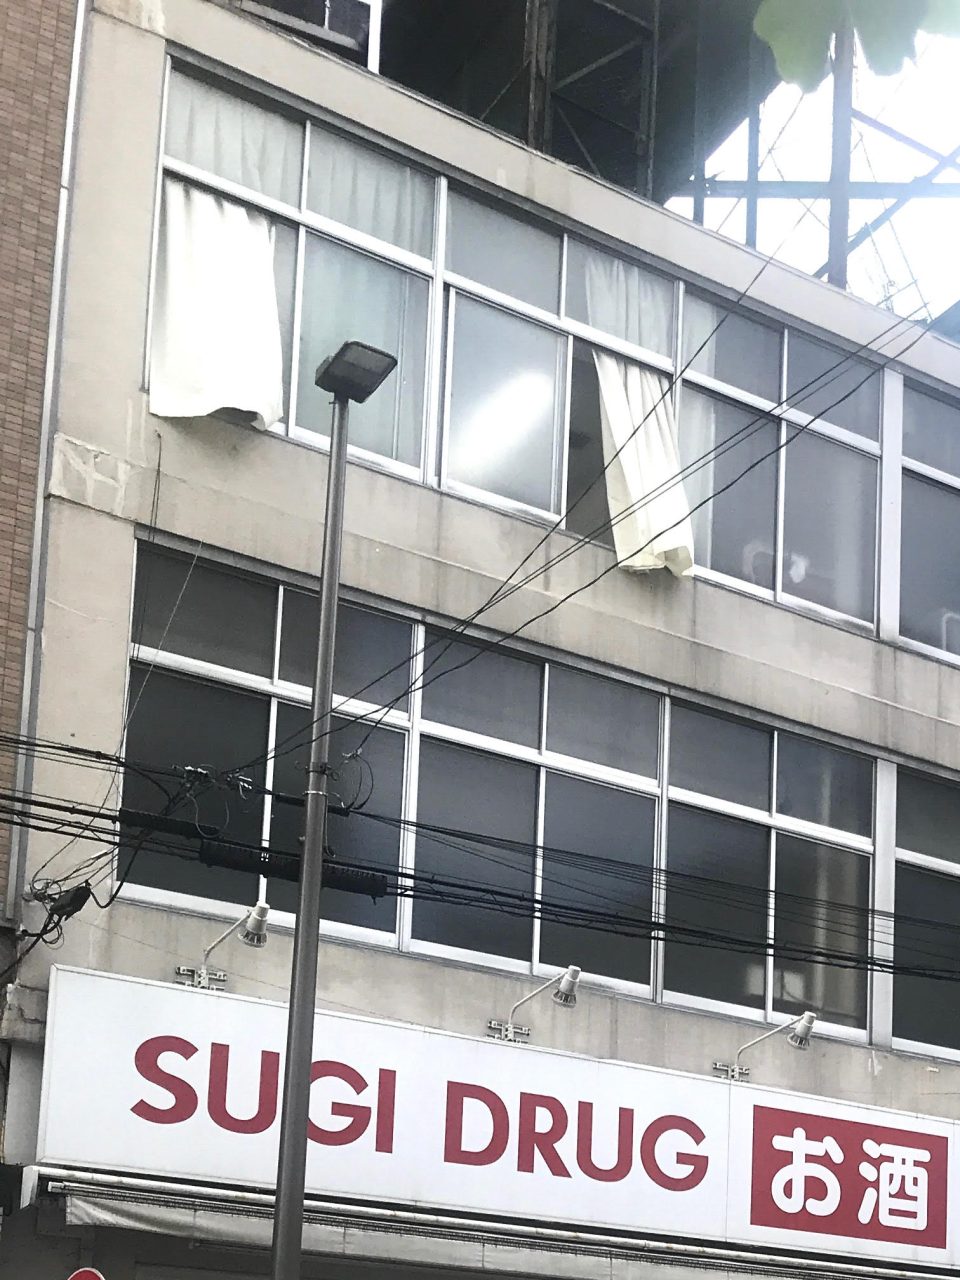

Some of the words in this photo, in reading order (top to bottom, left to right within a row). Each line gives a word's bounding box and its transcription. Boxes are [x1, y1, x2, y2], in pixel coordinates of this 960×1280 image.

[130, 1034, 397, 1154] SUGI
[443, 1080, 709, 1192] DRUG
[770, 1126, 931, 1232] お酒
